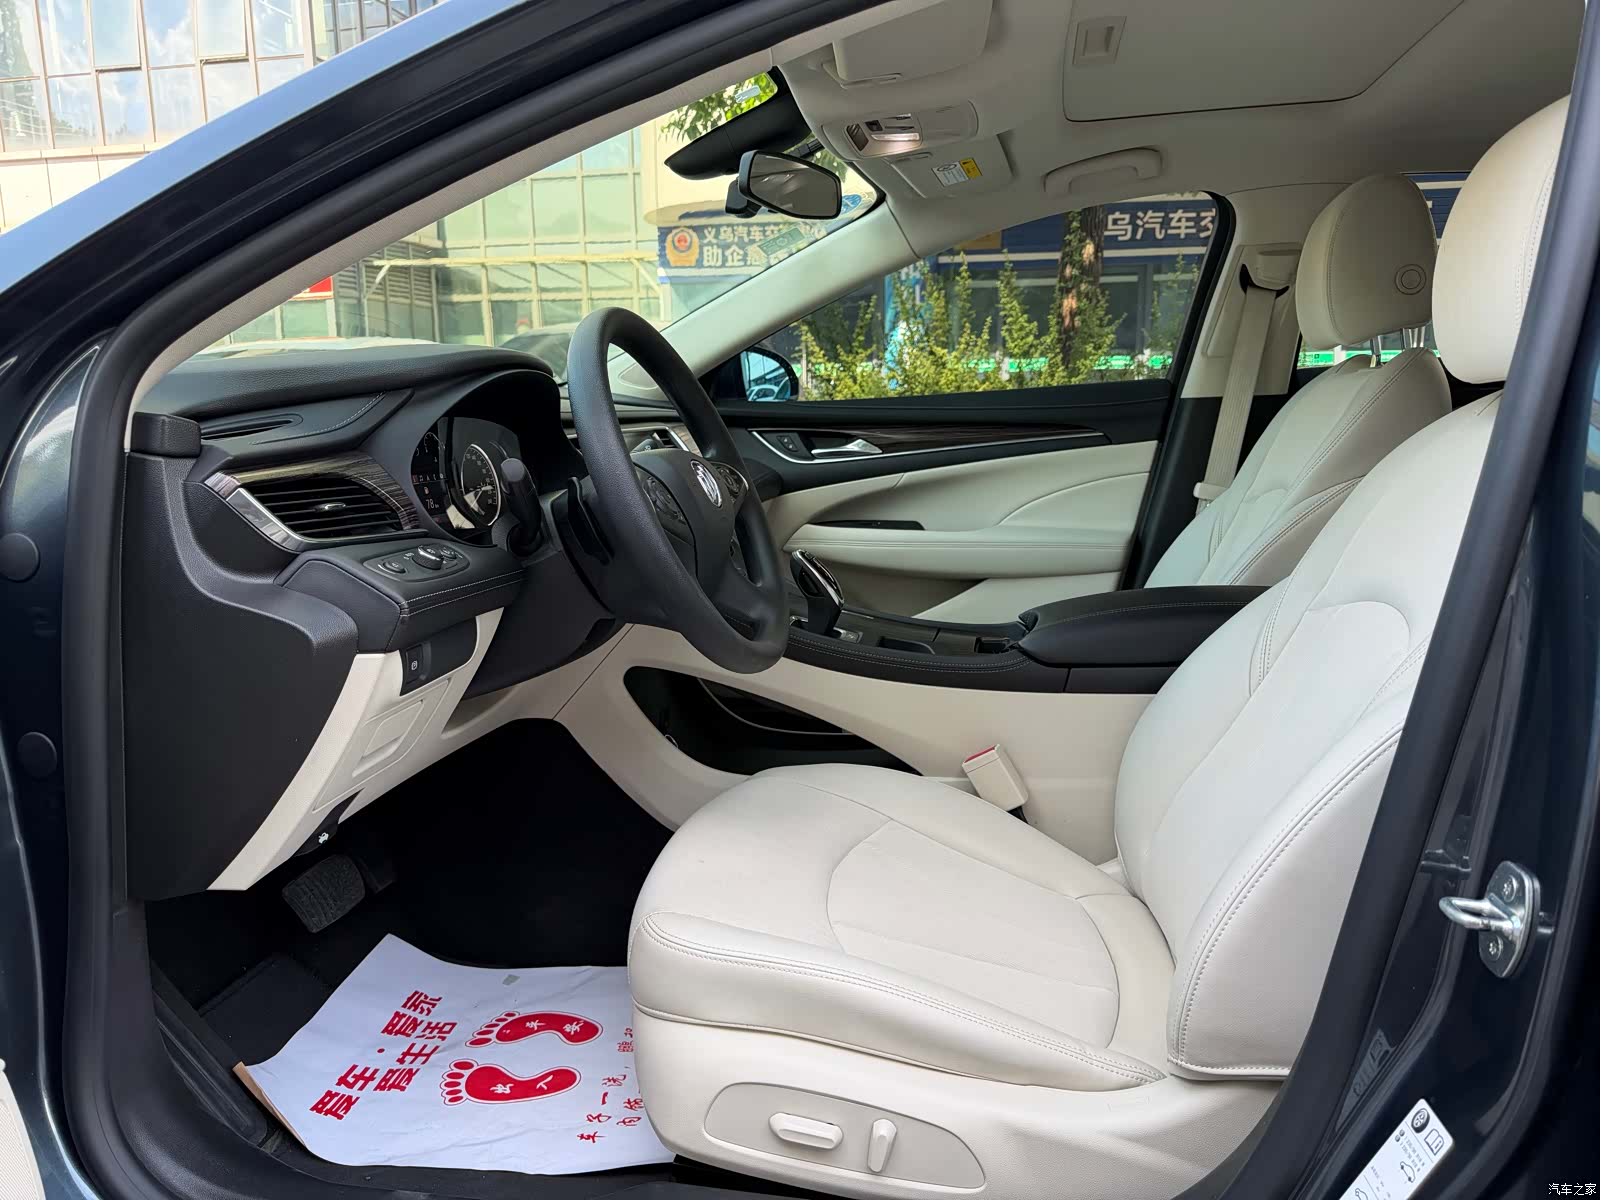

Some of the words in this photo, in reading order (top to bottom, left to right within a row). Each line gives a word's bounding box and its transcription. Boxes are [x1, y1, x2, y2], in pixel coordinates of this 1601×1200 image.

[373, 1021, 458, 1091] 爱生活
[490, 1075, 553, 1094] 出入
